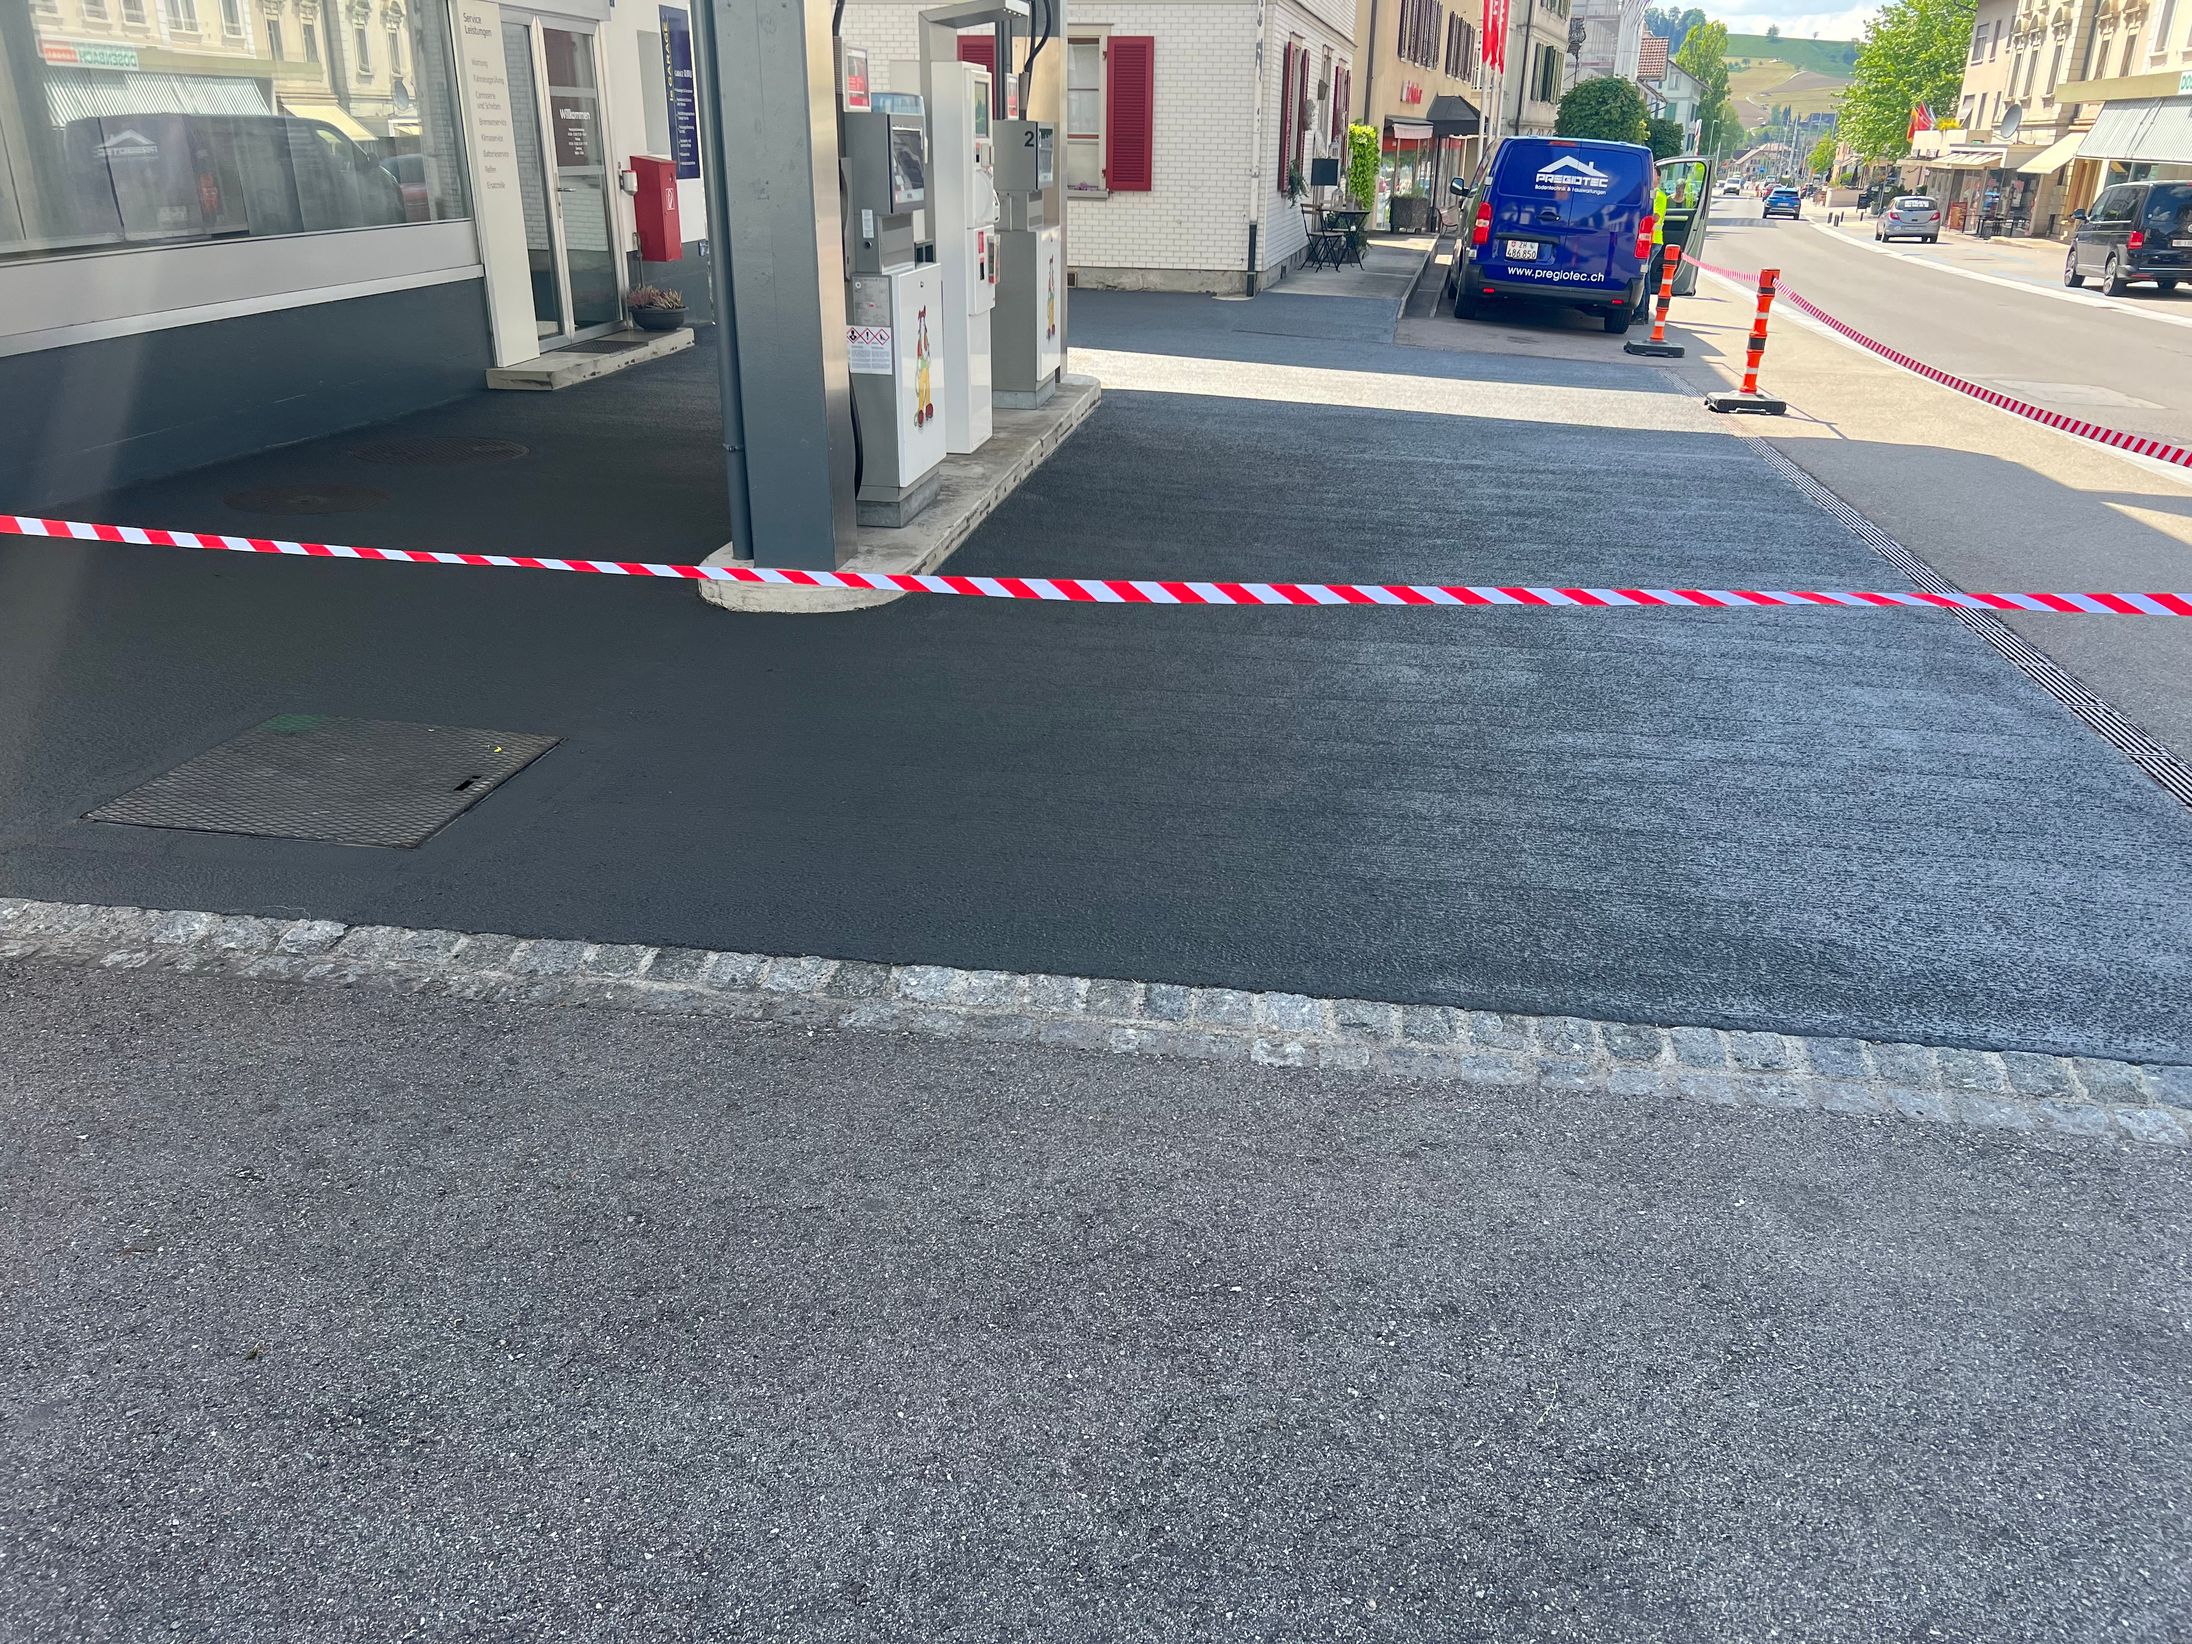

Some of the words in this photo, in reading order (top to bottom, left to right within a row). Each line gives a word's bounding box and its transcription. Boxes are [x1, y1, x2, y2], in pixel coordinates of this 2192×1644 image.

[463, 12, 482, 24] Service
[464, 25, 492, 38] Leistungen
[2181, 74, 2192, 90] DO
[560, 108, 591, 120] Willkommen
[1024, 131, 1035, 147] 2
[1536, 173, 1609, 188] PREGIOTEC
[1519, 240, 1527, 249] ZH
[1507, 248, 1521, 258] 486
[1522, 250, 1536, 259] 850
[1507, 266, 1605, 282] www.pregiotec.ch
